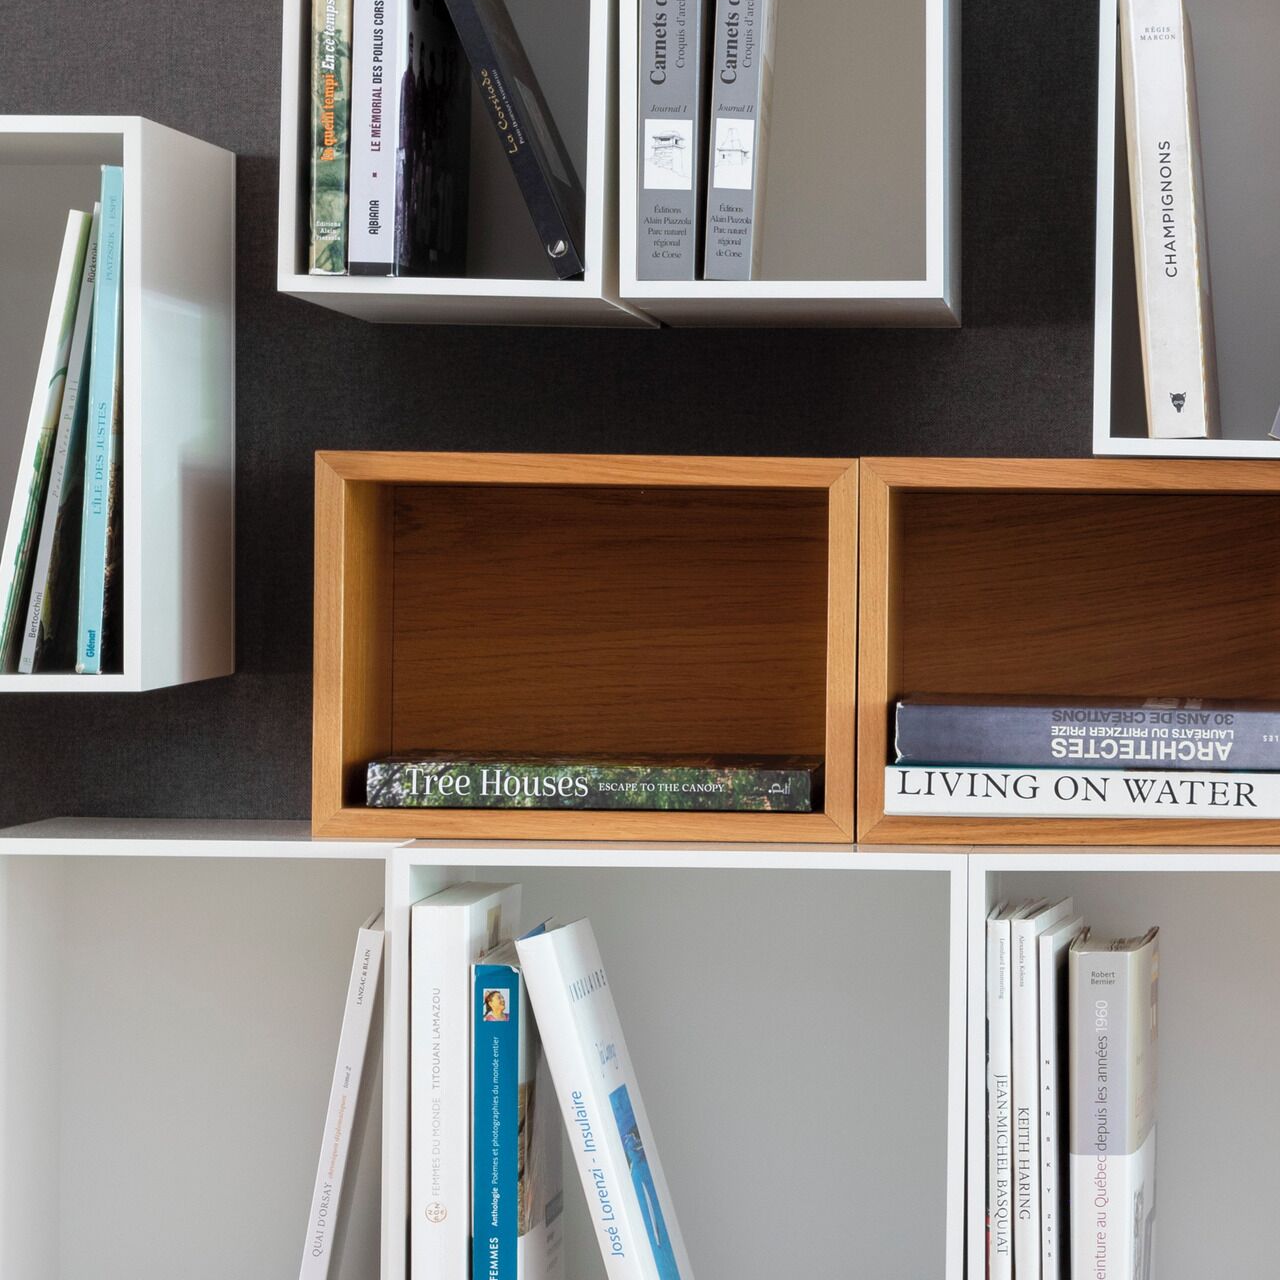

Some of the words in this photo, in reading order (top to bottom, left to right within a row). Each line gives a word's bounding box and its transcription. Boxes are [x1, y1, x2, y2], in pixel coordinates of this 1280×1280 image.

[1144, 25, 1170, 33] RÉGIS
[372, 28, 384, 63] POILUS
[650, 12, 668, 86] Carnets
[675, 29, 688, 68] Croquis
[720, 12, 740, 85] Carnets
[743, 29, 755, 68] Croquis
[321, 54, 335, 71] En
[372, 65, 383, 84] DES
[321, 73, 338, 109] tempi
[481, 68, 508, 131] Corsiade
[369, 87, 382, 138] MÉMORIAL
[650, 104, 681, 113] Journal
[717, 103, 746, 113] Journal
[746, 105, 754, 113] II
[371, 141, 381, 152] LE
[507, 133, 518, 154] La
[643, 216, 663, 225] Alain
[663, 216, 692, 225] Piazzola
[654, 204, 682, 214] Éditions
[710, 215, 726, 223] Alain
[727, 216, 752, 225] Piazzola
[719, 203, 743, 213] Éditions
[1158, 140, 1178, 278] CHAMPIGNONS
[647, 227, 663, 235] Parc
[664, 228, 687, 236] naturel
[653, 239, 681, 248] régional
[713, 226, 726, 234] Parc
[727, 227, 748, 235] naturel
[718, 238, 742, 247] régional
[651, 250, 661, 258] de
[661, 250, 682, 259] Corse
[716, 249, 724, 257] de
[724, 250, 743, 258] Corse
[96, 402, 107, 450] JUSTES
[95, 454, 104, 482] DES
[28, 592, 43, 638] Bertocchini
[86, 629, 96, 658] Glénat
[1051, 710, 1146, 725] CRÉATIONS
[1051, 725, 1087, 736] PRIZE
[1150, 711, 1174, 724] DE
[1176, 712, 1211, 725] ANS
[1215, 714, 1234, 726] 30
[1089, 726, 1149, 737] PRITZKER
[1151, 728, 1169, 738] DU
[1171, 728, 1234, 740] LAURÉATS
[1051, 737, 1234, 761] ARCHITECTES
[404, 768, 471, 796] Tree
[480, 768, 589, 798] Houses
[599, 782, 638, 792] ESCAPE
[640, 782, 655, 792] TO
[657, 782, 680, 792] THE
[682, 783, 725, 792] CANOPY
[897, 770, 1039, 801] LIVING
[1053, 775, 1110, 803] ON
[1122, 778, 1258, 807] WATER
[356, 976, 367, 1006] LANZAC
[363, 949, 371, 970] BLAIN
[431, 987, 441, 1040] LAMAZOU
[1095, 1000, 1108, 1033] 1960
[491, 1037, 500, 1058] entier
[1094, 1035, 1108, 1082] années
[343, 1072, 351, 1088] tome
[431, 1045, 441, 1090] TITOUAN
[491, 1061, 500, 1084] monde
[491, 1084, 500, 1095] du
[1094, 1086, 1107, 1104] les
[431, 1097, 441, 1137] MONDE
[491, 1095, 501, 1147] photographies
[571, 1090, 597, 1153] Insulaire
[994, 1074, 1008, 1174] JEAN-MICHEL
[1017, 1107, 1030, 1153] KEITH
[1094, 1108, 1110, 1152] depuis
[431, 1138, 441, 1156] DU
[492, 1148, 500, 1157] et
[431, 1157, 441, 1197] FEMMES
[491, 1159, 500, 1185] Poèmes
[1094, 1155, 1109, 1208] Québec
[588, 1167, 615, 1222] Lorenzi
[1018, 1159, 1031, 1221] HARING
[317, 1182, 332, 1228] D'ORSAY
[491, 1186, 501, 1227] Anthologie
[994, 1179, 1009, 1257] BASQUIAT
[1097, 1213, 1107, 1228] au
[311, 1230, 325, 1258] QUAI
[604, 1226, 625, 1258] José
